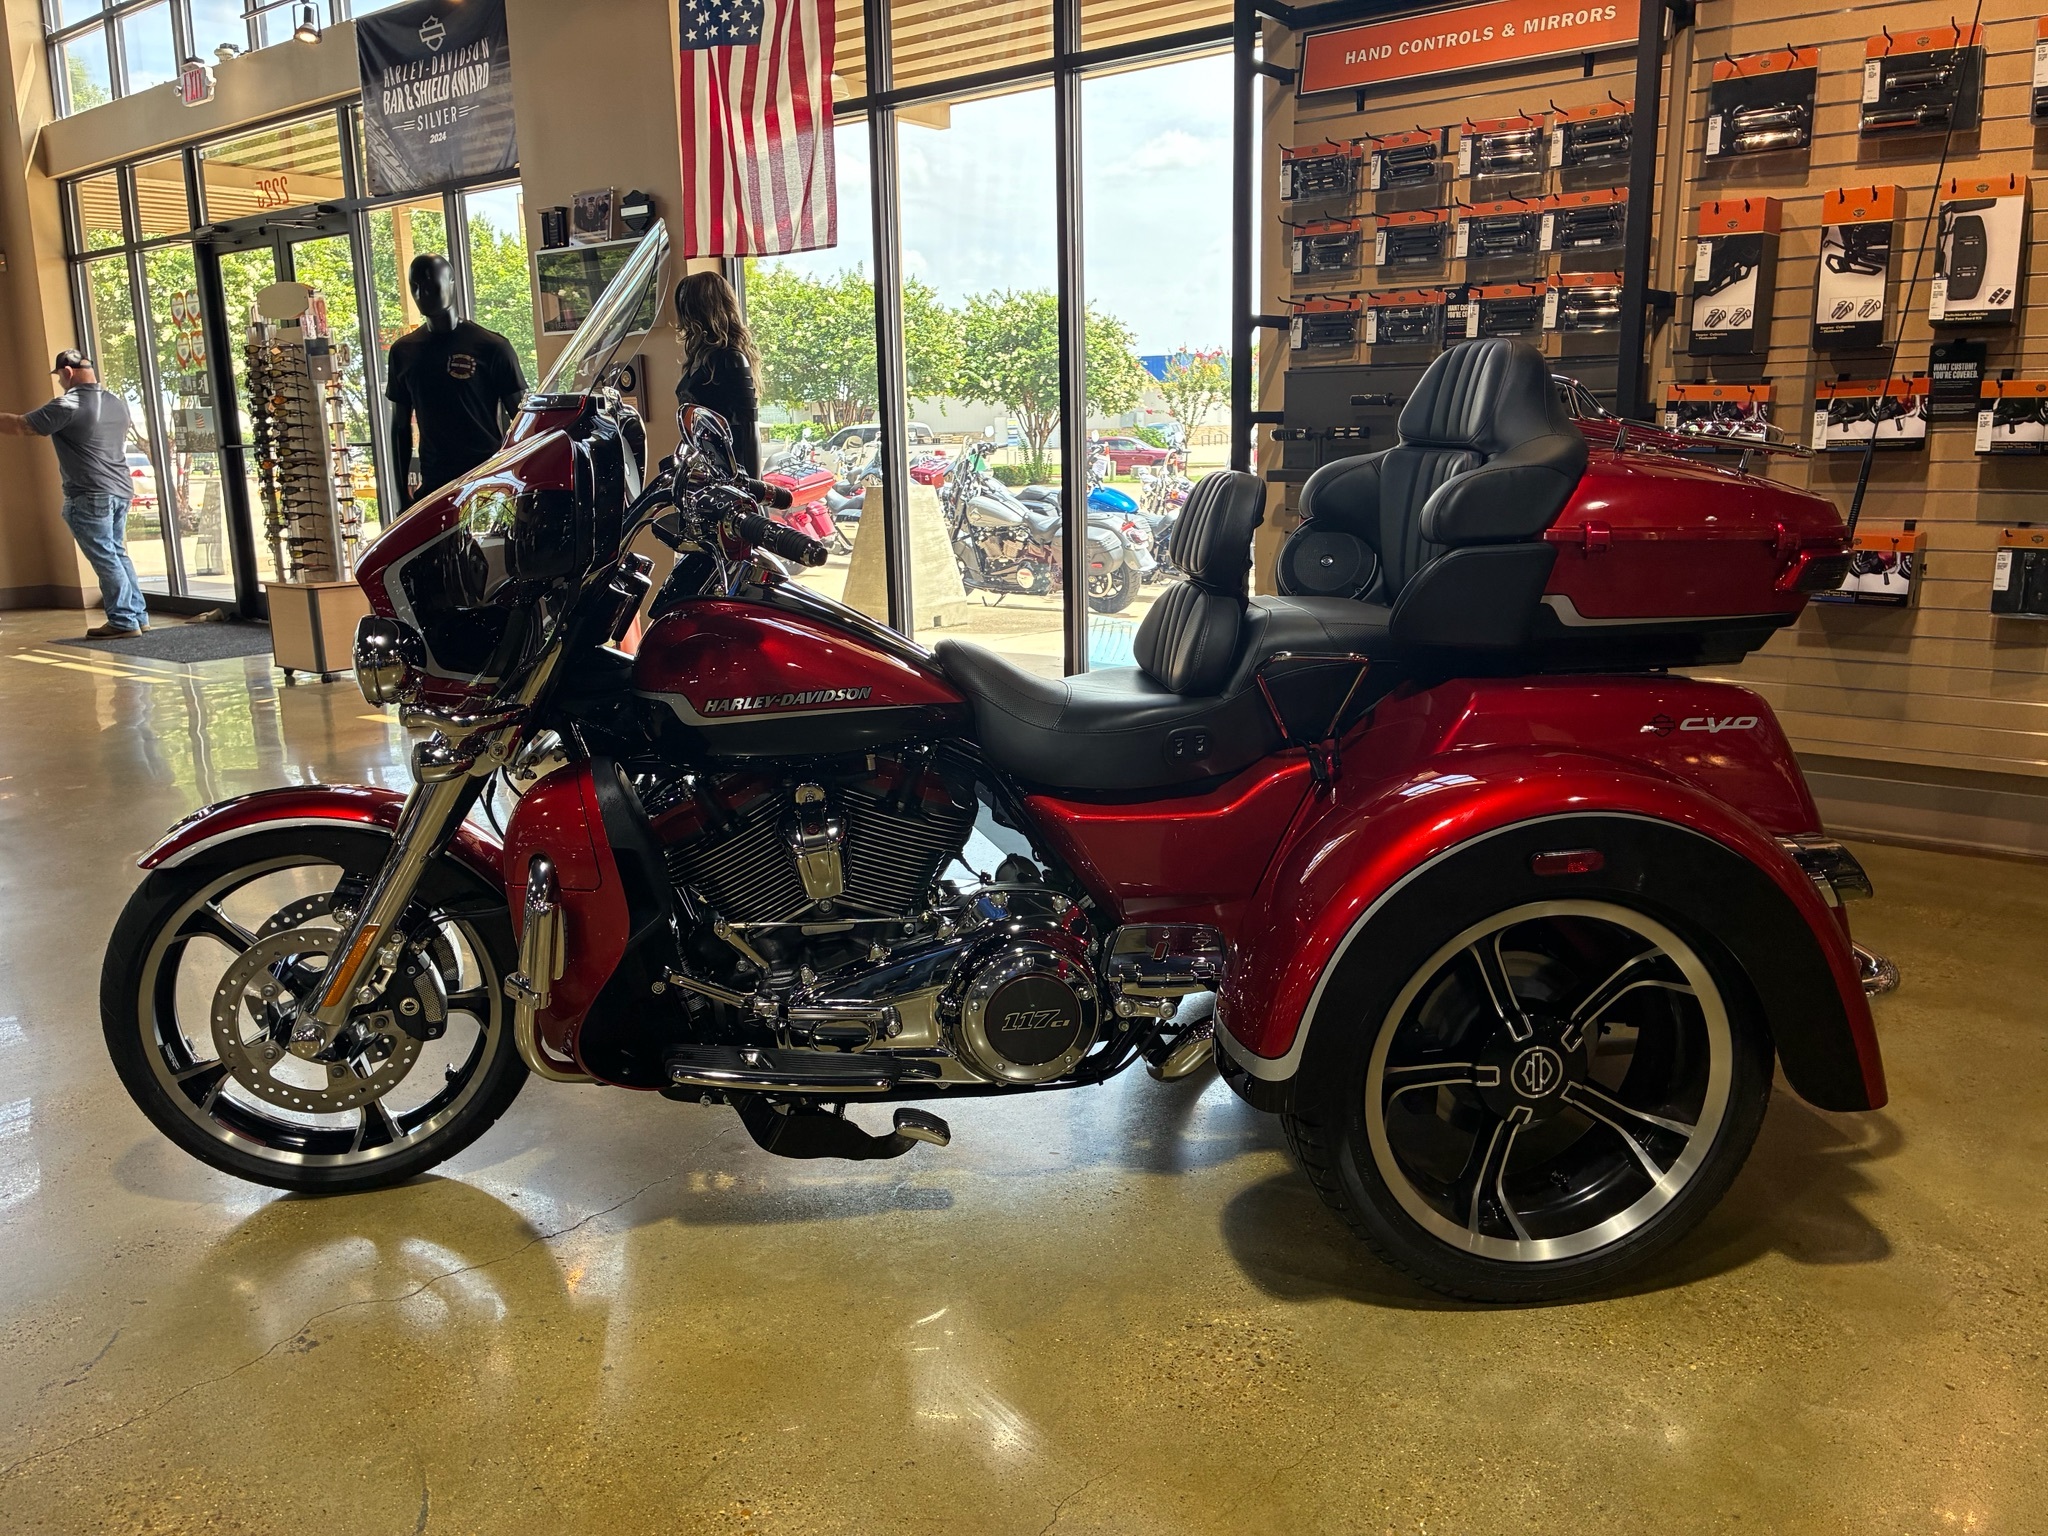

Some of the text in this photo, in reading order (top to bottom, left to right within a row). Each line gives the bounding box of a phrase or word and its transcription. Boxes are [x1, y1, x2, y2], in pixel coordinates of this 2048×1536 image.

[1345, 5, 1617, 65] HAND CONTROLS & MIRRORS
[384, 38, 491, 88] HARLEY-DAVIDSON
[183, 69, 204, 102] EXIT
[383, 88, 405, 116] BAR
[413, 74, 450, 109] SHIELD
[451, 62, 489, 98] AWARD
[417, 106, 457, 132] SILVER
[429, 131, 447, 144] 2024
[1933, 362, 1978, 371] WANT CUSTOM?
[1933, 371, 1952, 379] YOU'RE
[703, 686, 872, 713] HARLEY-DAVIDSON
[1680, 716, 1758, 733] CVO
